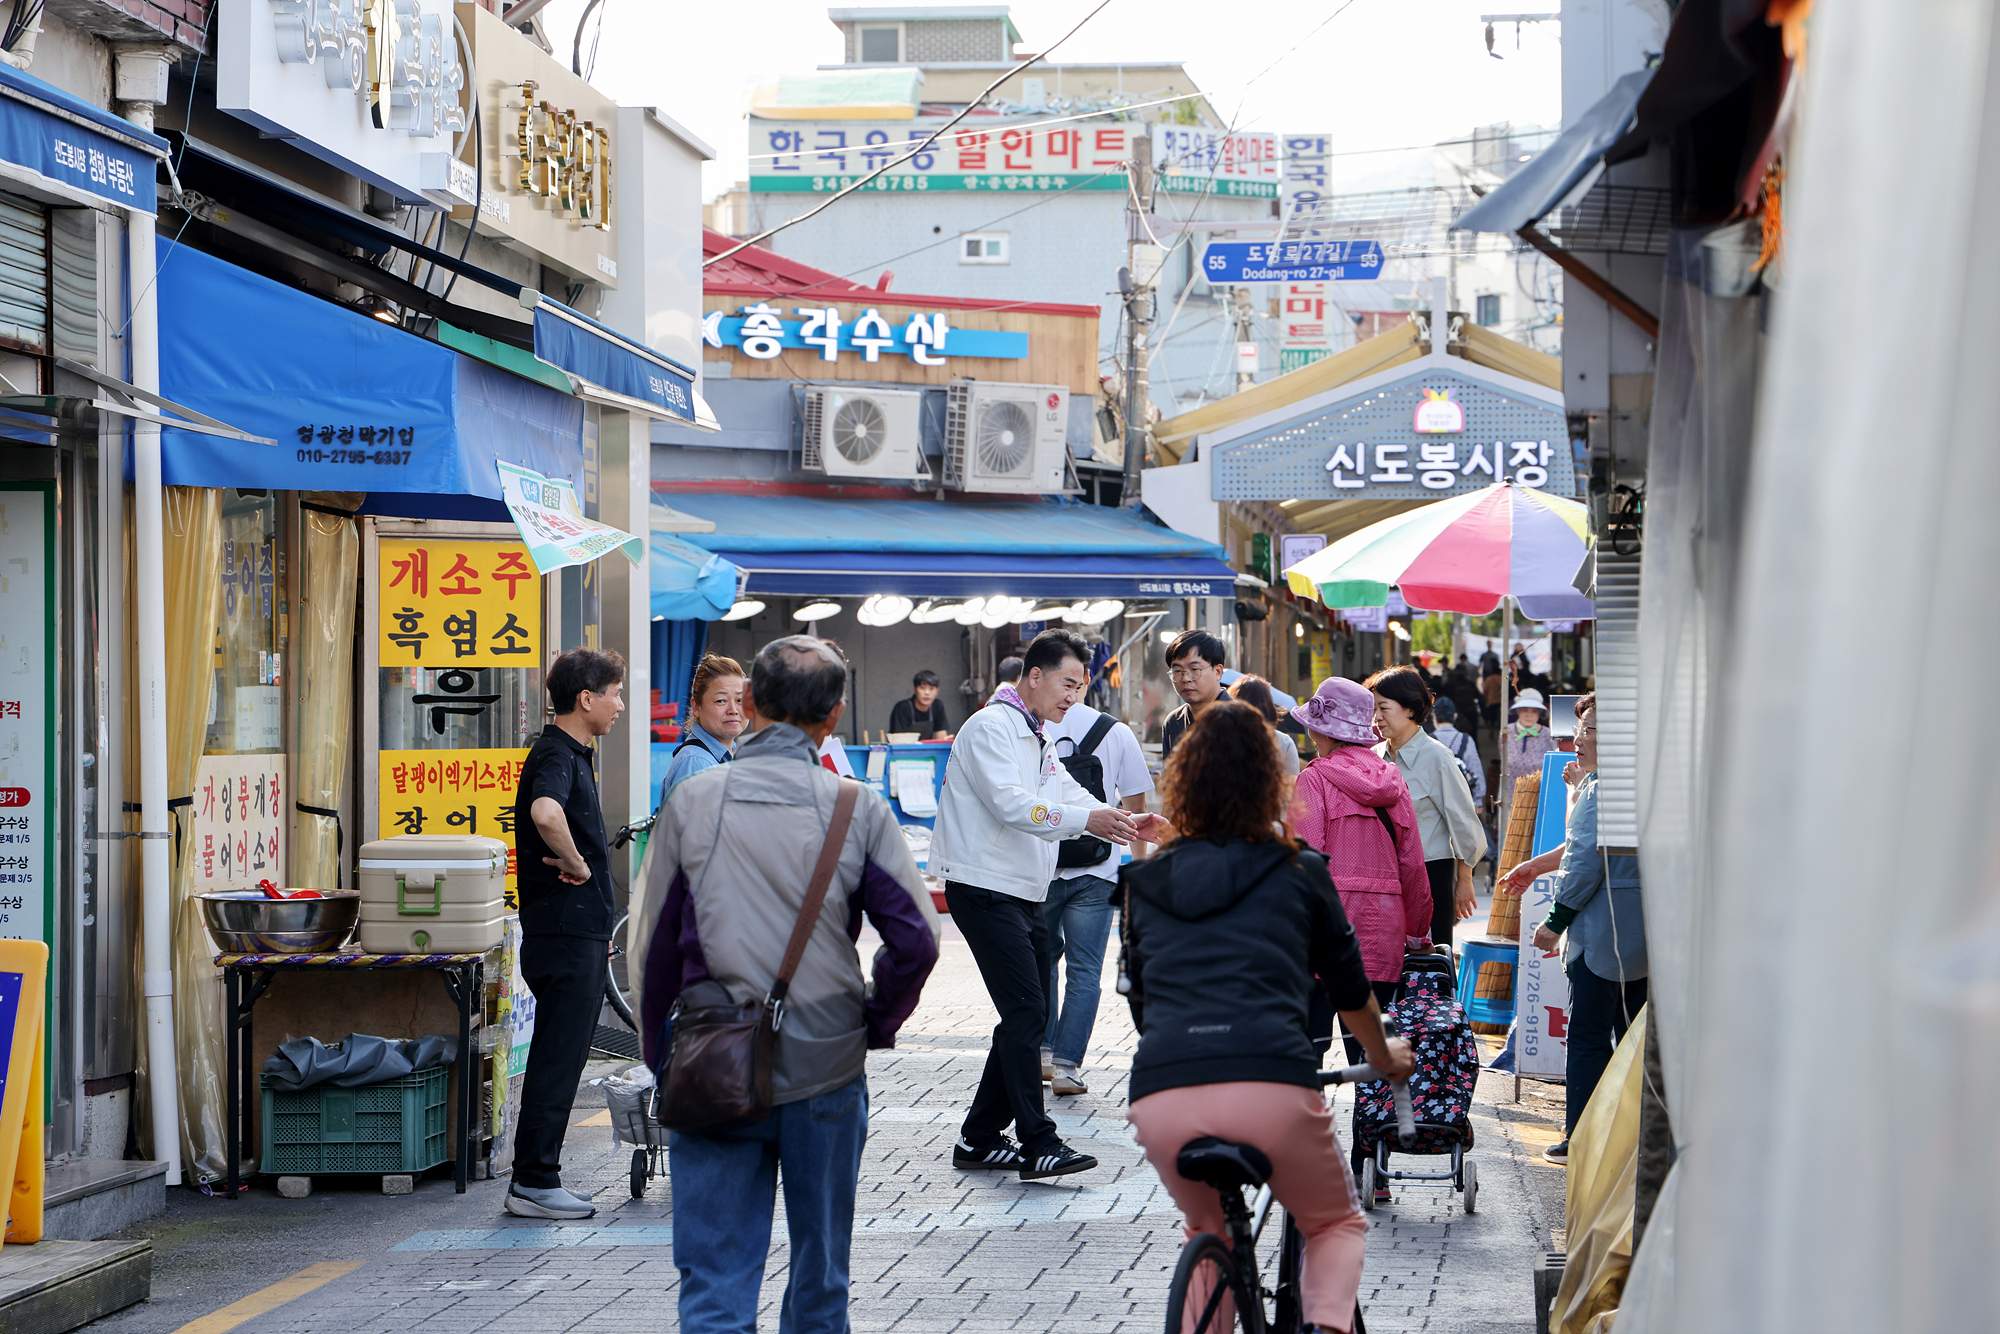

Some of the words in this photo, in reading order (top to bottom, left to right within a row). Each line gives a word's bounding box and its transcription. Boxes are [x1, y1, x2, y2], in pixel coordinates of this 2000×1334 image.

[768, 129, 941, 171] 한국유통
[955, 128, 1127, 171] 할인마트
[1164, 130, 1218, 174] 한국유통
[1222, 136, 1276, 176] 할인마트
[54, 138, 87, 174] 신도봉시장
[88, 147, 108, 186] 정화
[106, 155, 135, 196] 부동산
[1207, 255, 1228, 270] 55
[1241, 266, 1308, 281] Dodang-ro
[1309, 265, 1345, 281] 27-gil
[1359, 252, 1379, 268] 59
[740, 301, 950, 366] 총각수산
[1046, 412, 1058, 422] LG
[1324, 439, 1556, 490] 신도봉시장
[221, 538, 275, 620] 붕어즙
[389, 548, 532, 601] 개소주
[1172, 582, 1211, 594] 총각수산
[387, 607, 532, 660] 흑염소
[393, 805, 516, 835] 장어즙
[16, 833, 30, 844] 1/5
[0, 873, 16, 883] 문제
[17, 873, 33, 884] 3/5
[0, 895, 23, 910] 수상
